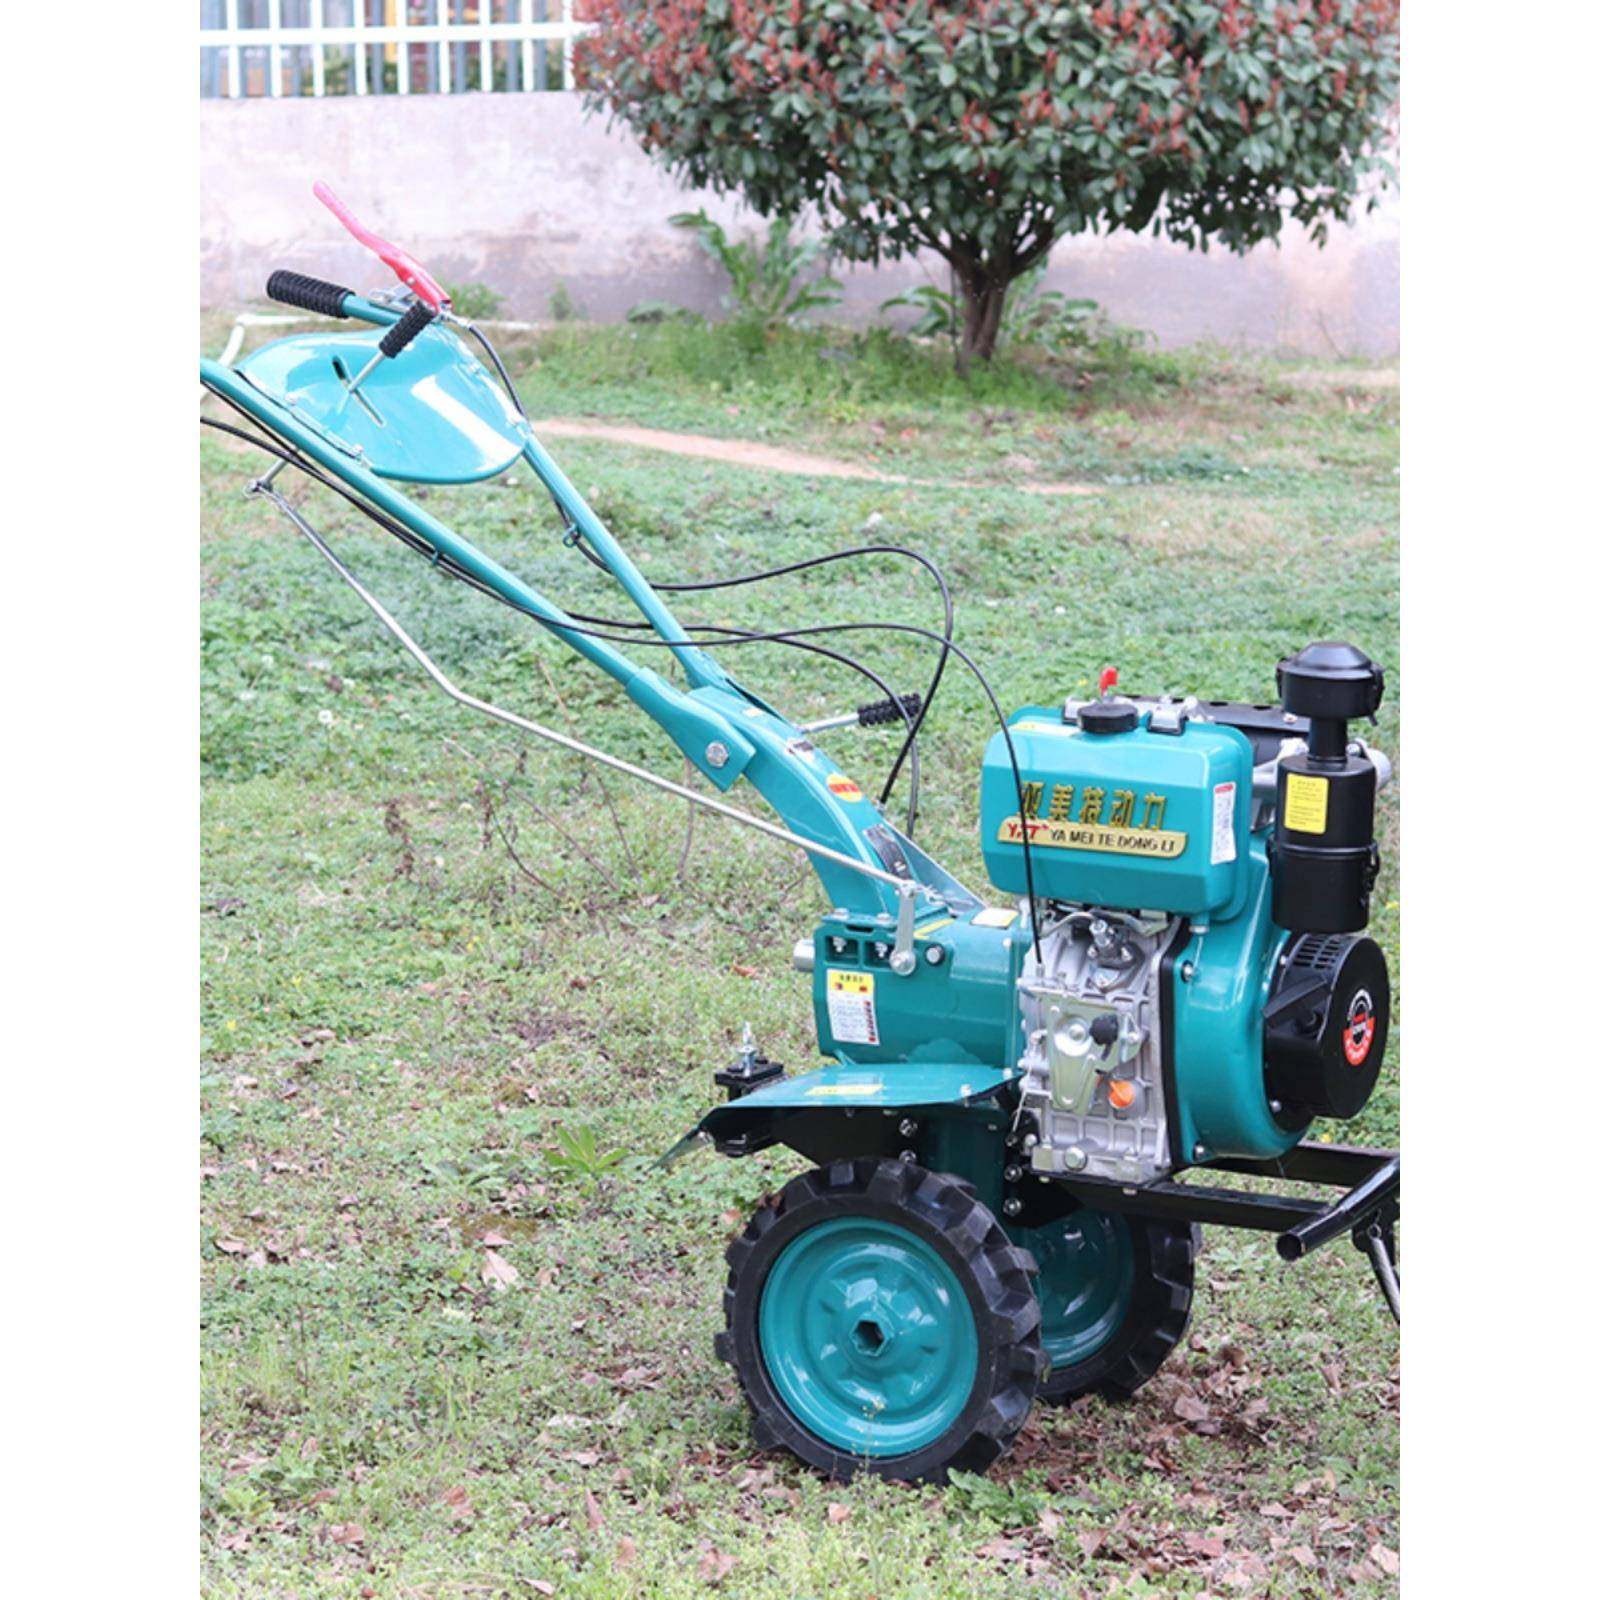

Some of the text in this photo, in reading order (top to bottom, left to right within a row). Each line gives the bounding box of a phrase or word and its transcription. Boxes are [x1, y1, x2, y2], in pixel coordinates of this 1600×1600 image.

[1051, 829, 1175, 852] YA MEI TE DONG LI
